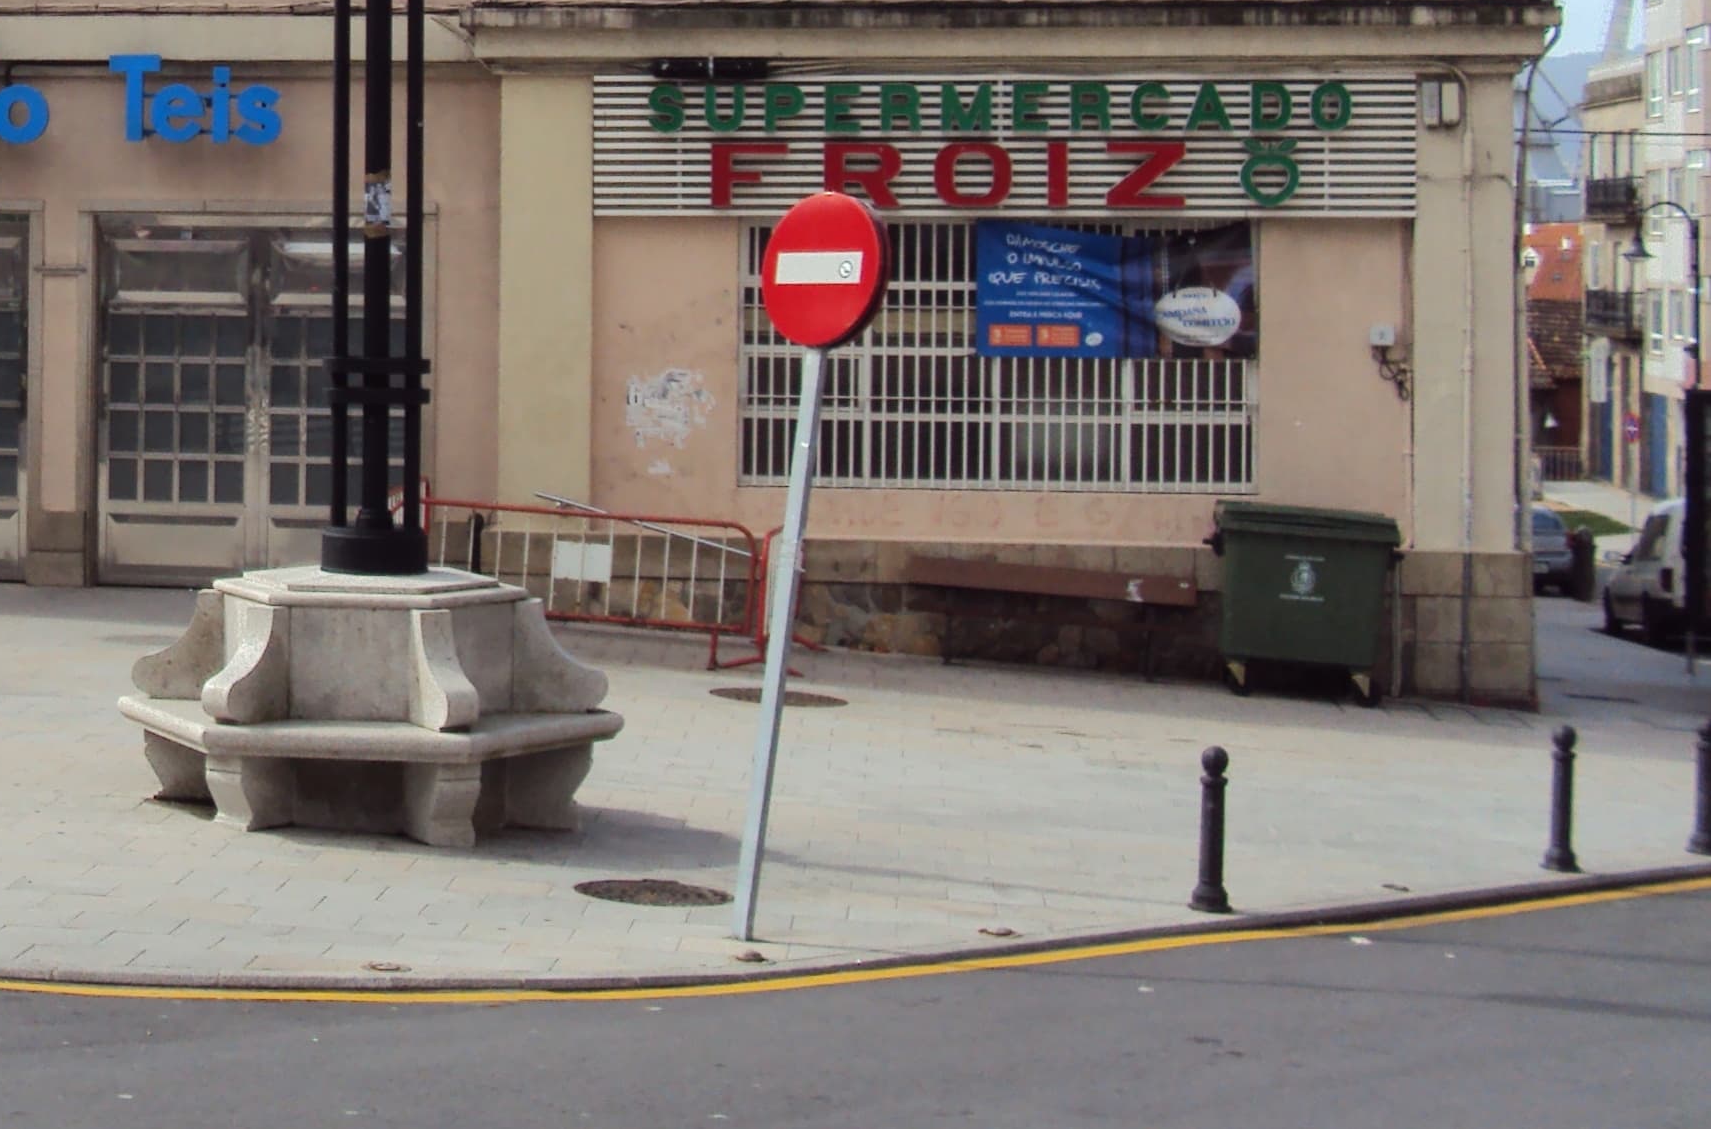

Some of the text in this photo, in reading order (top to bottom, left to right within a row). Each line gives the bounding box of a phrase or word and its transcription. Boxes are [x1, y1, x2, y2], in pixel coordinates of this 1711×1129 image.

[109, 54, 283, 146] Teis
[647, 81, 1353, 134] SUPERMERCADO
[710, 141, 1187, 209] FROIZ
[988, 271, 1027, 286] QUE
